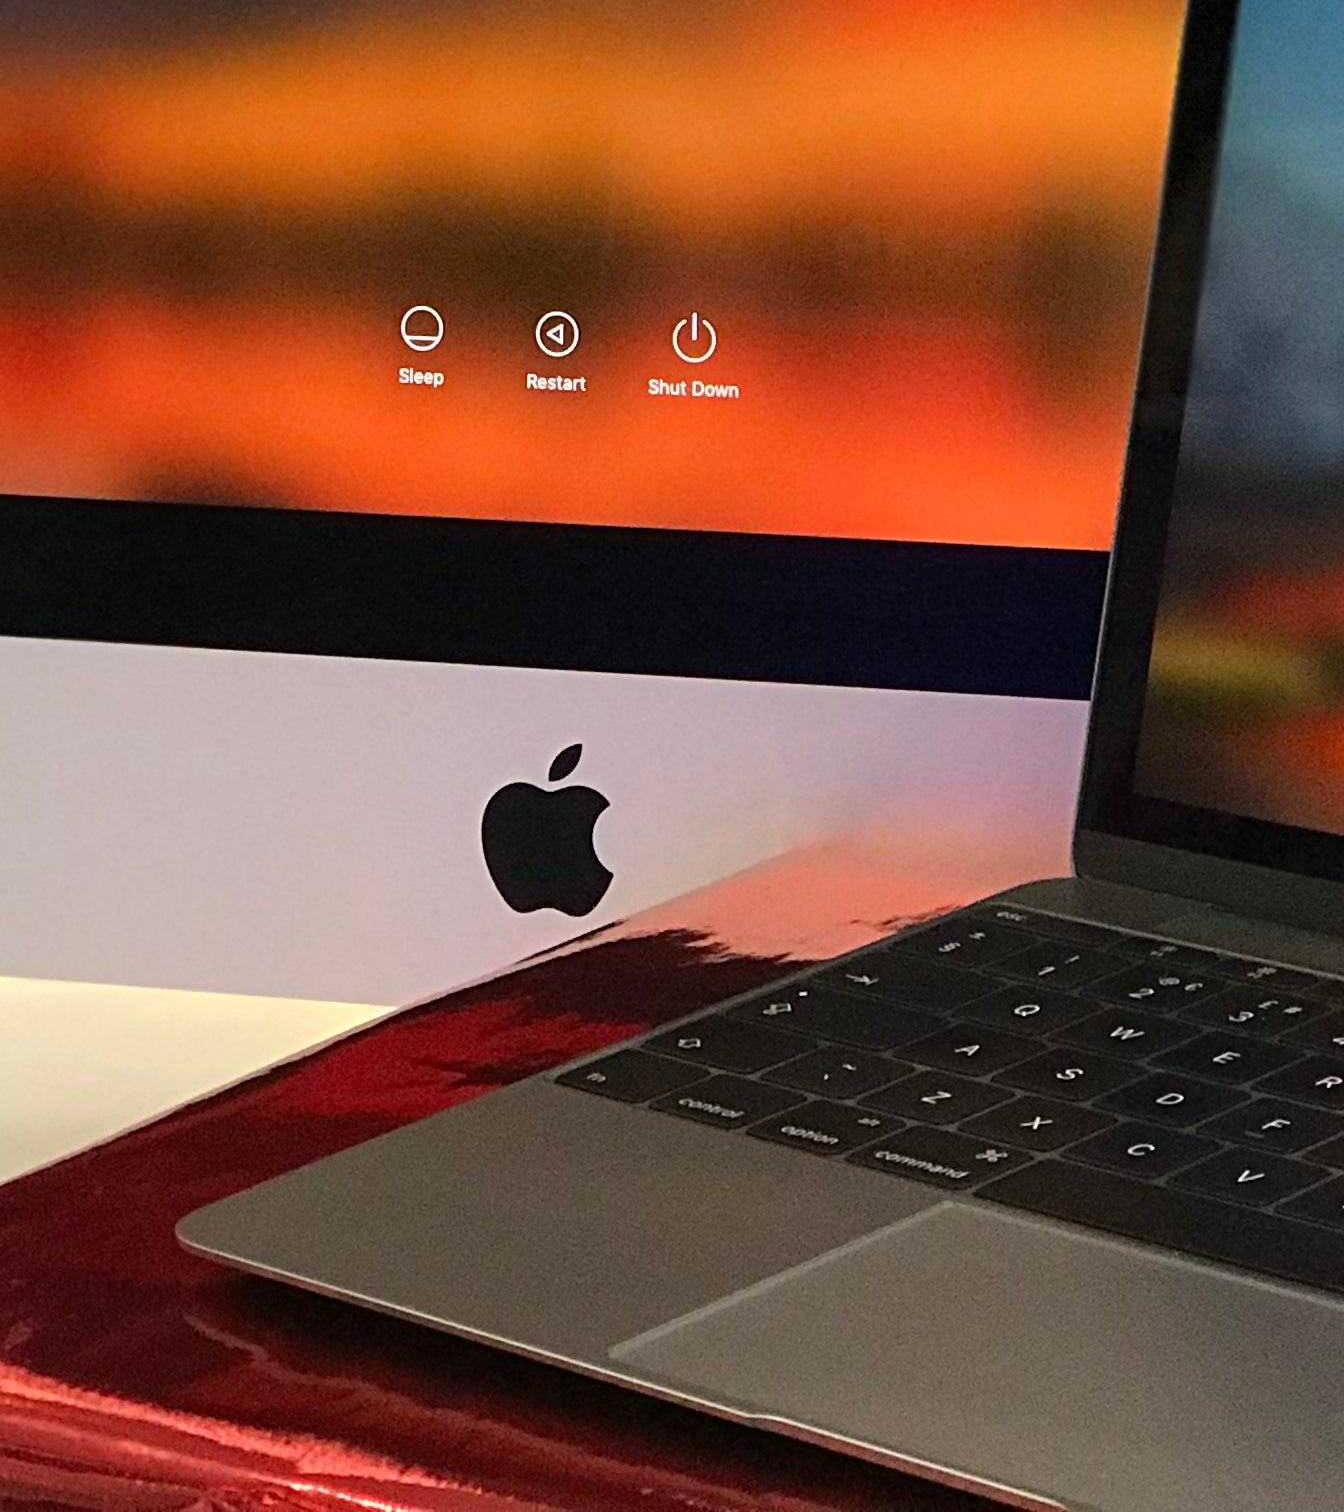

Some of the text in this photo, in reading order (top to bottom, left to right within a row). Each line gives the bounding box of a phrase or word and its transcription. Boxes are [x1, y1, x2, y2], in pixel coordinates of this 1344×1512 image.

[398, 367, 445, 388] Sleep
[526, 373, 587, 392] Restart
[648, 378, 740, 399] Shut Down
[1013, 1003, 1042, 1018] Q
[1109, 1025, 1145, 1041] W
[953, 1043, 981, 1057] A
[1211, 1050, 1242, 1065] E
[1055, 1067, 1085, 1081] S
[1314, 1074, 1344, 1090] R
[920, 1089, 953, 1105] Z
[1155, 1091, 1186, 1106] D
[677, 1096, 746, 1120] control
[1020, 1115, 1054, 1131] X
[1260, 1117, 1292, 1131] F
[779, 1124, 841, 1147] option
[1126, 1142, 1157, 1157] C
[873, 1148, 971, 1181] command
[1236, 1168, 1266, 1184] V
